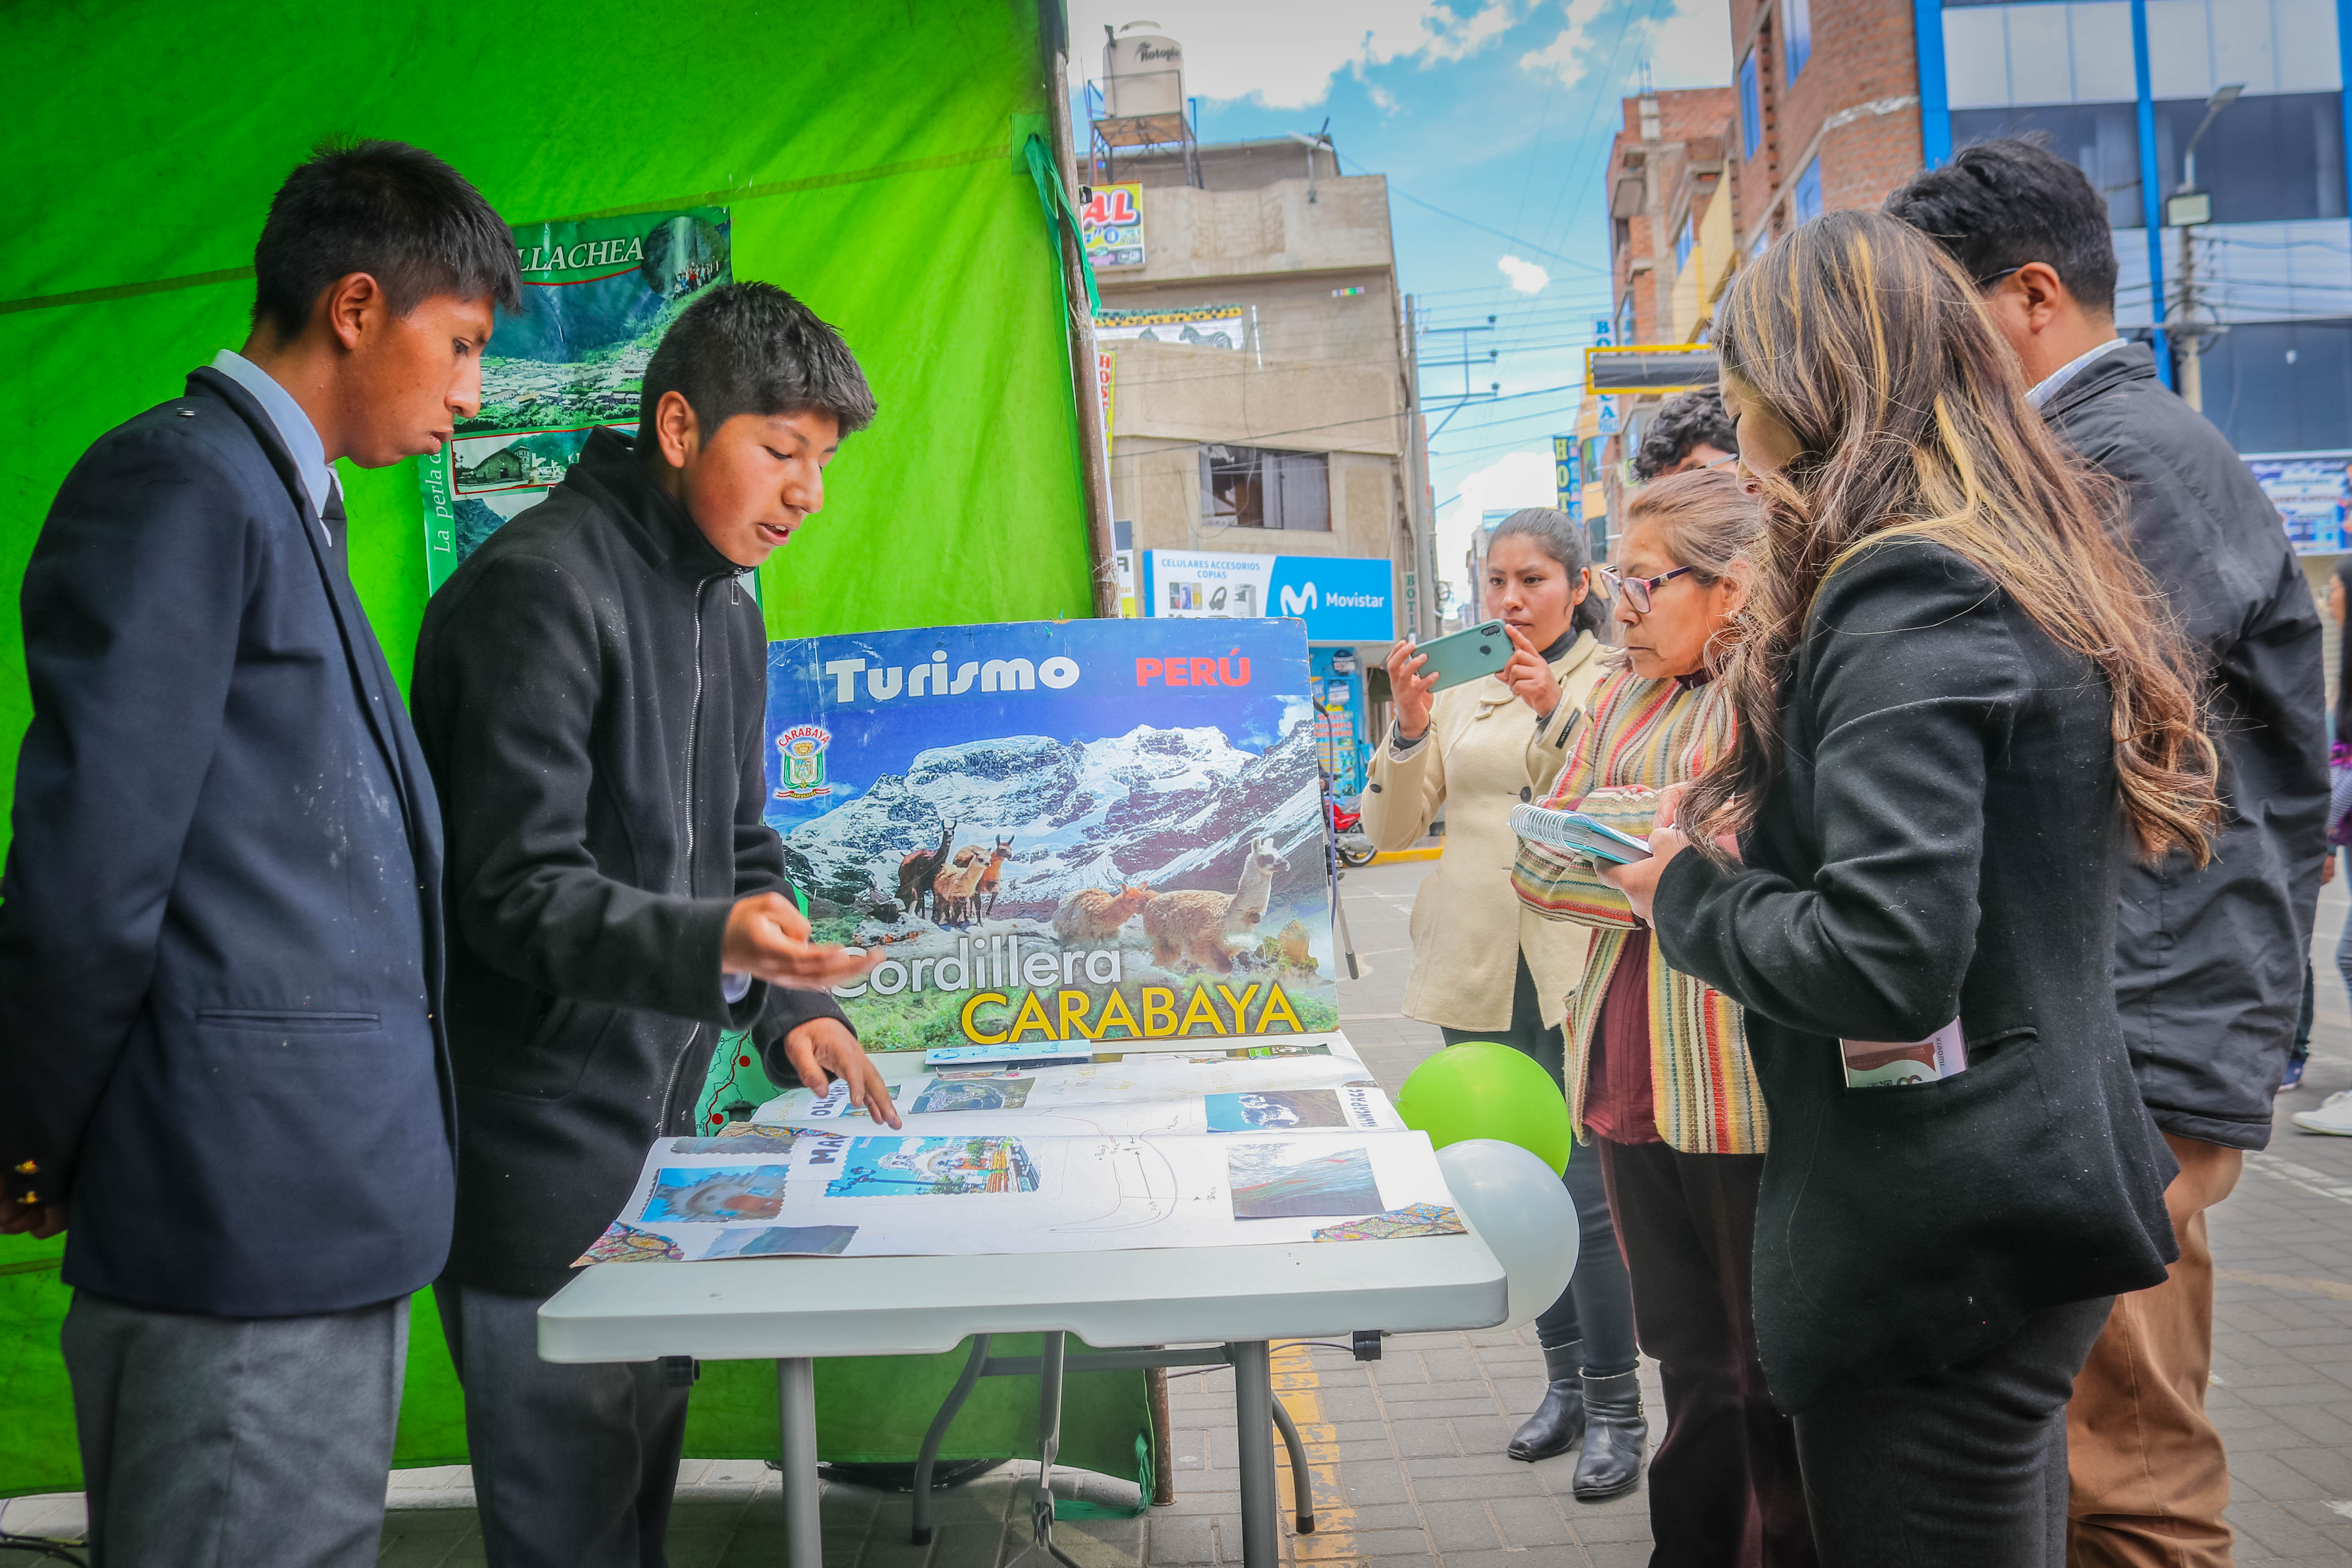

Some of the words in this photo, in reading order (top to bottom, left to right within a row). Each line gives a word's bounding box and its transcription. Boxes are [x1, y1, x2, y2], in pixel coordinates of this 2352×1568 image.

[425, 469, 453, 520] perla
[433, 529, 450, 554] La
[1161, 559, 1209, 569] CELULARES
[1210, 560, 1260, 570] ACCESORIOS
[1197, 570, 1227, 579] COPIAS
[1326, 591, 1385, 608] Movistar
[825, 649, 1080, 703] Turismo
[1136, 648, 1251, 686] PERÚ
[778, 727, 830, 746] CARABAYA
[961, 982, 1306, 1045] CARABAYA
